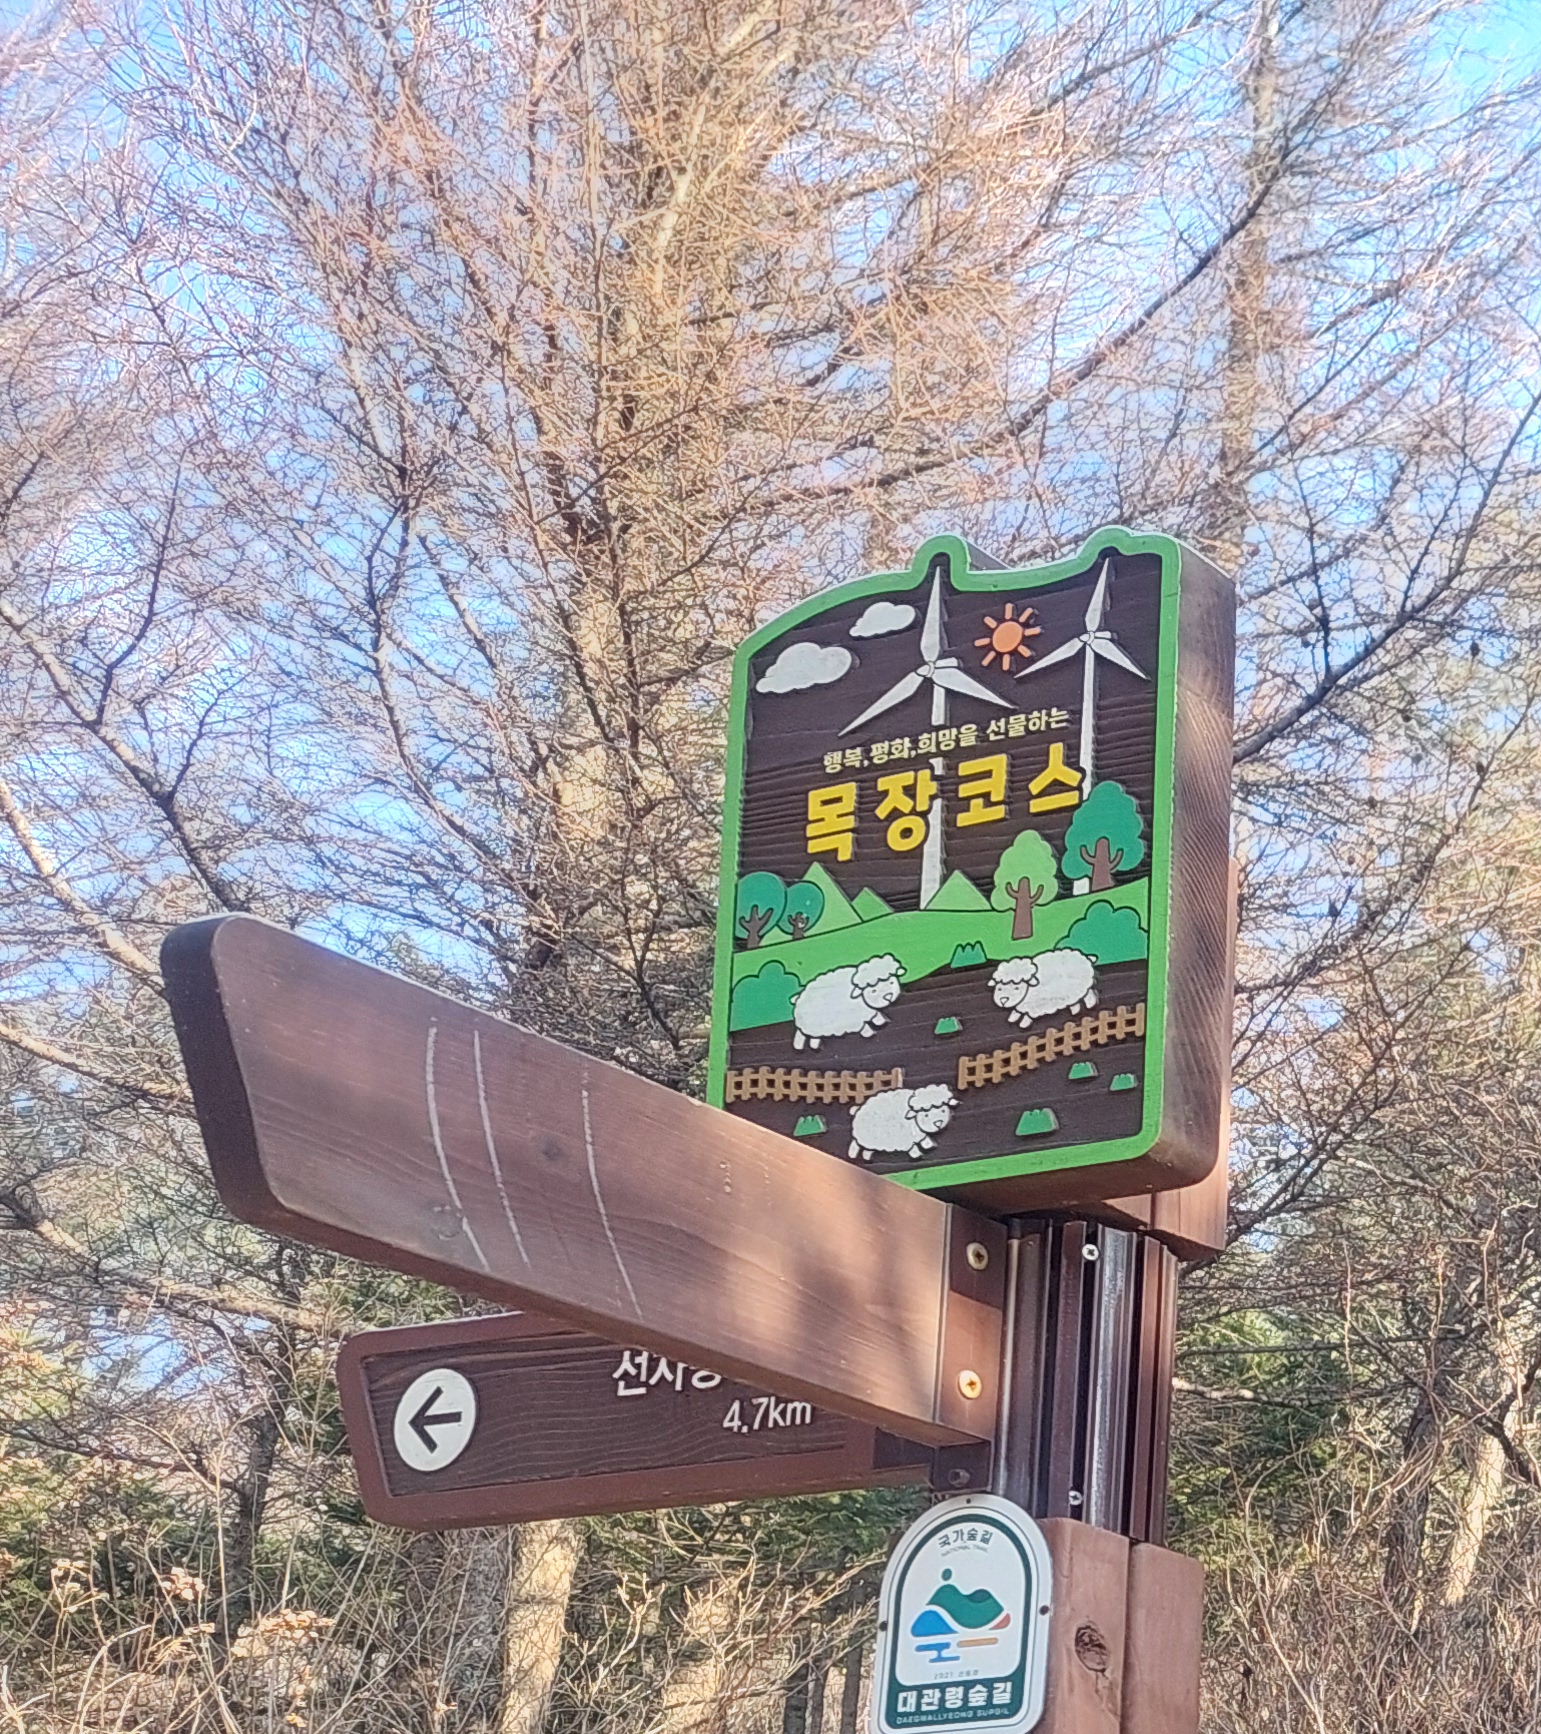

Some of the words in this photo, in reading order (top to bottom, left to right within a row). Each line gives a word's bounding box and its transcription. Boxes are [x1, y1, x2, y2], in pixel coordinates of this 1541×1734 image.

[822, 723, 978, 774] 행복,평화,희망을
[986, 707, 1070, 742] 선물하는
[805, 742, 1083, 862] 목장코스
[723, 1397, 812, 1433] 4.7km
[938, 1527, 993, 1548] 국가숲길
[897, 1681, 1013, 1713] 대관령숲길
